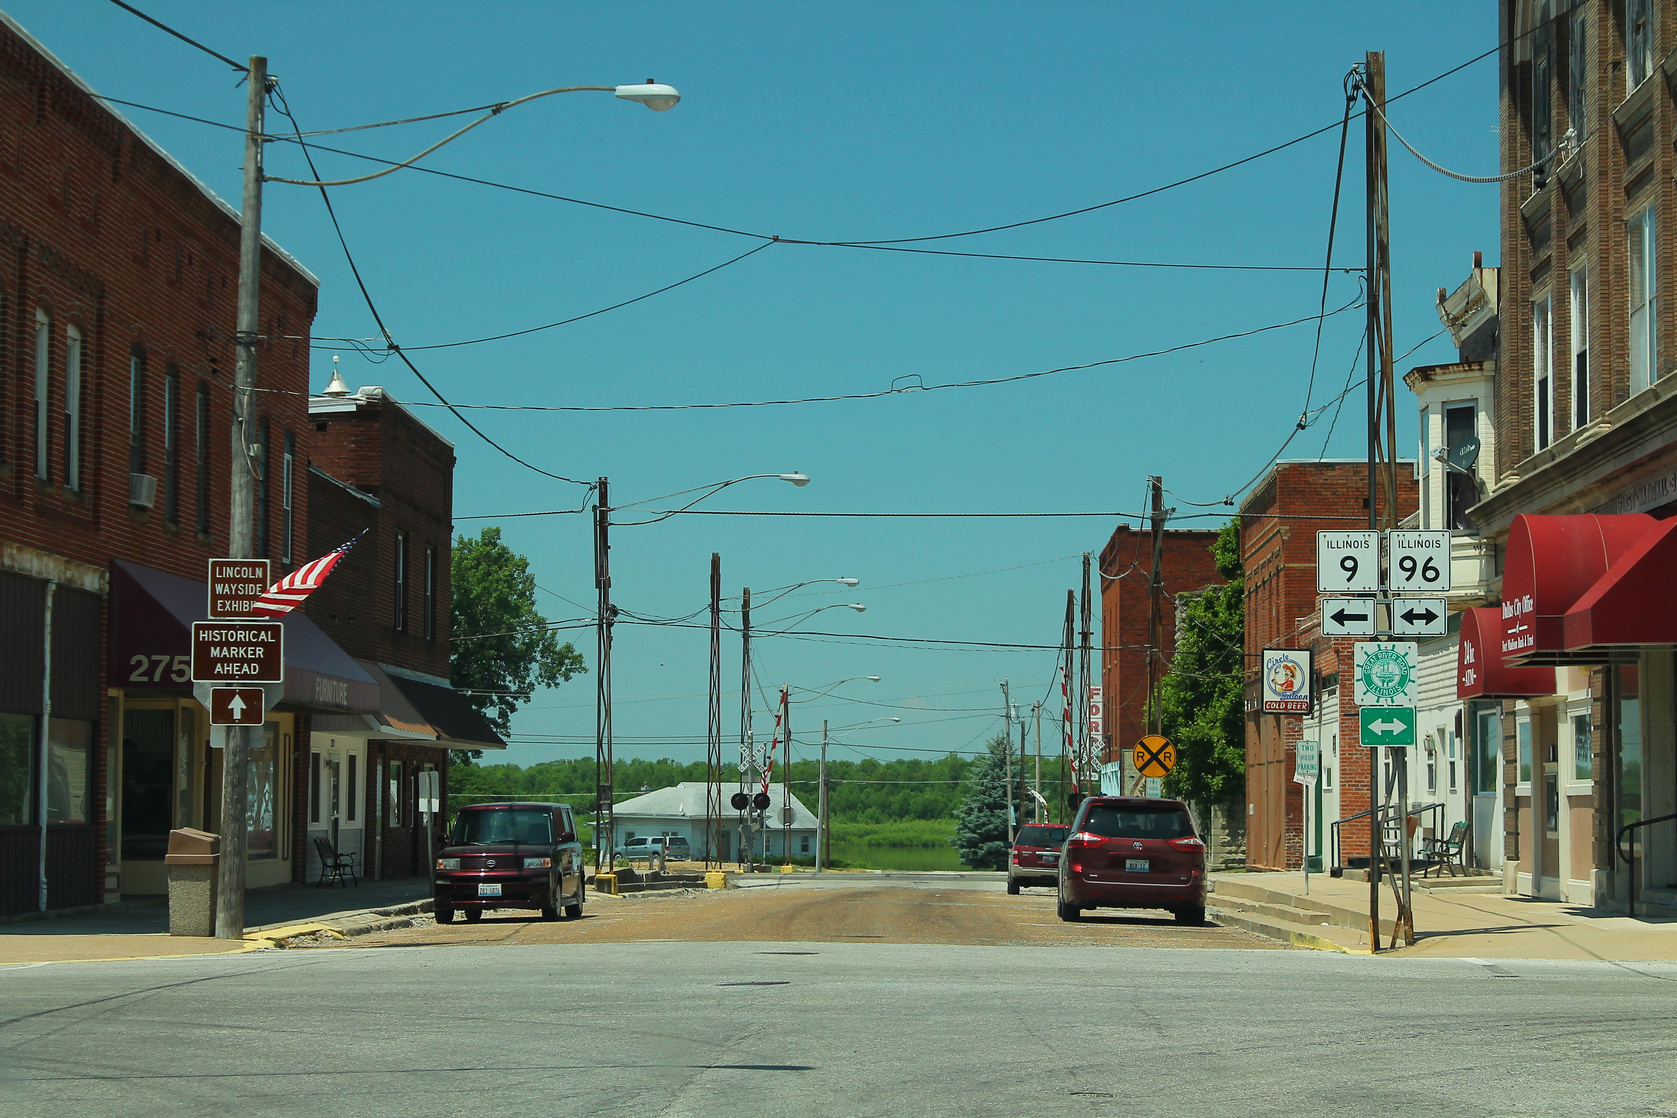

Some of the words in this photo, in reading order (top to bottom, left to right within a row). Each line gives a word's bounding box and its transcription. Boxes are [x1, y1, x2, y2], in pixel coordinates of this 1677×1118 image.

[1327, 540, 1370, 549] ILLINOIS
[1398, 539, 1441, 549] ILLINOIS
[215, 566, 263, 579] LINCOLN
[1340, 555, 1359, 583] 9
[1398, 555, 1440, 583] 96
[215, 583, 263, 596] WAYSIDE
[216, 599, 256, 612] EXHIBI
[199, 630, 276, 642] HISTORICAL
[210, 646, 264, 659] MARKER
[1266, 653, 1289, 670] Circle
[1364, 655, 1378, 675] GREAT
[1377, 652, 1397, 661] RIVER
[1397, 658, 1408, 675] ROAD
[128, 654, 191, 683] 275
[214, 663, 260, 675] AHEAD
[315, 677, 348, 705] FURNITURE
[1280, 691, 1308, 701] Saloon
[1369, 684, 1402, 696] ILLINOIS
[1266, 701, 1286, 709] COLD
[1287, 701, 1308, 710] BEER
[1136, 751, 1146, 762] R
[1163, 751, 1173, 762] R
[1297, 763, 1318, 771] PARKING
